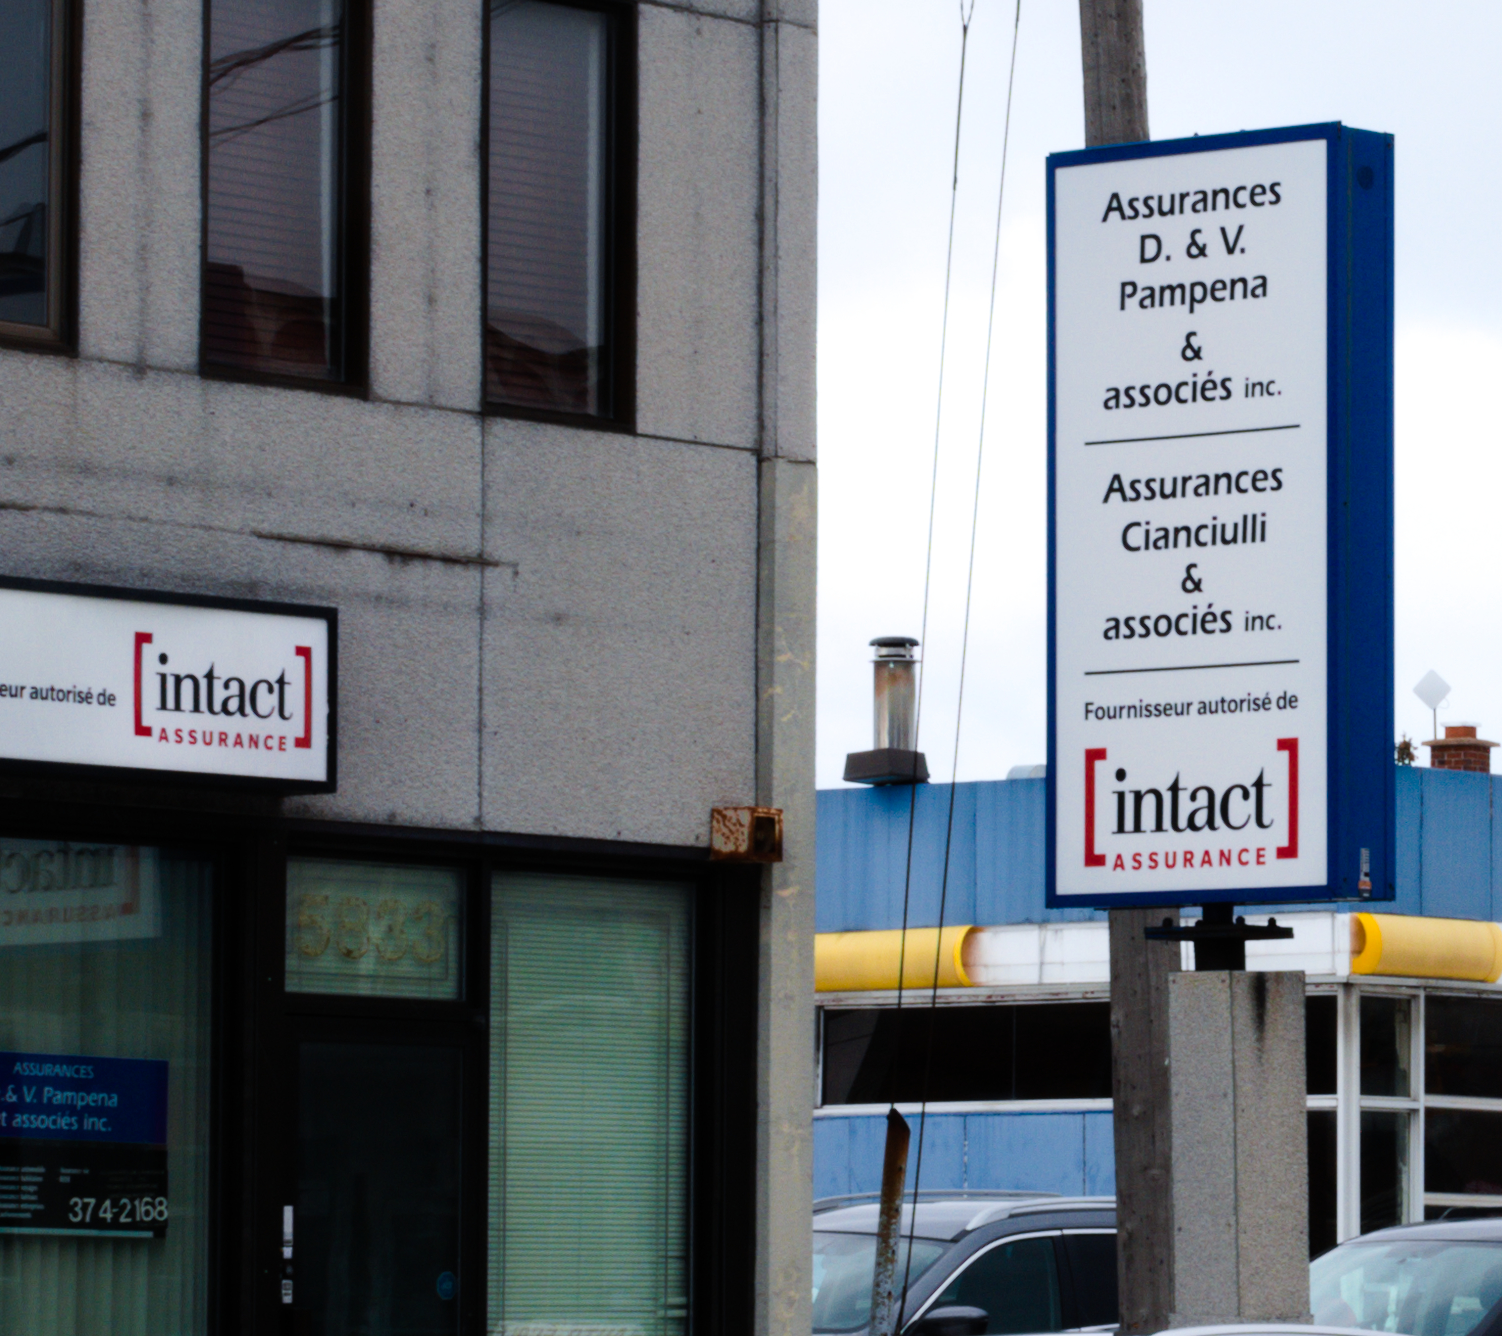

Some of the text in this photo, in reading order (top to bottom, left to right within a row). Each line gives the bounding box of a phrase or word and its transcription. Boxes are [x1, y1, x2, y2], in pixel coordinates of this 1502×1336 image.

[1101, 181, 1282, 223] Assurances
[1139, 224, 1246, 264] D. & V.
[1119, 274, 1268, 314] Pampena
[1181, 331, 1203, 362] &
[1103, 370, 1282, 410] associés inc.
[1102, 467, 1284, 504] Assurances
[1121, 512, 1267, 552] Cianciulli
[1181, 563, 1203, 594] &
[1102, 603, 1282, 641] associés inc.
[29, 685, 94, 706] autorisé
[97, 690, 117, 707] de
[154, 652, 294, 721] intact
[1084, 690, 1299, 721] Fournisseur autorisé de
[158, 727, 288, 752] ASSURANCE
[1110, 767, 1274, 836] intact
[1112, 846, 1268, 872] ASSURANCE
[12, 1060, 95, 1079] ASSURANCES
[41, 1086, 119, 1110] Pampena
[11, 1110, 78, 1130] associés
[82, 1113, 113, 1133] inc.
[67, 1195, 169, 1224] 374-2168
